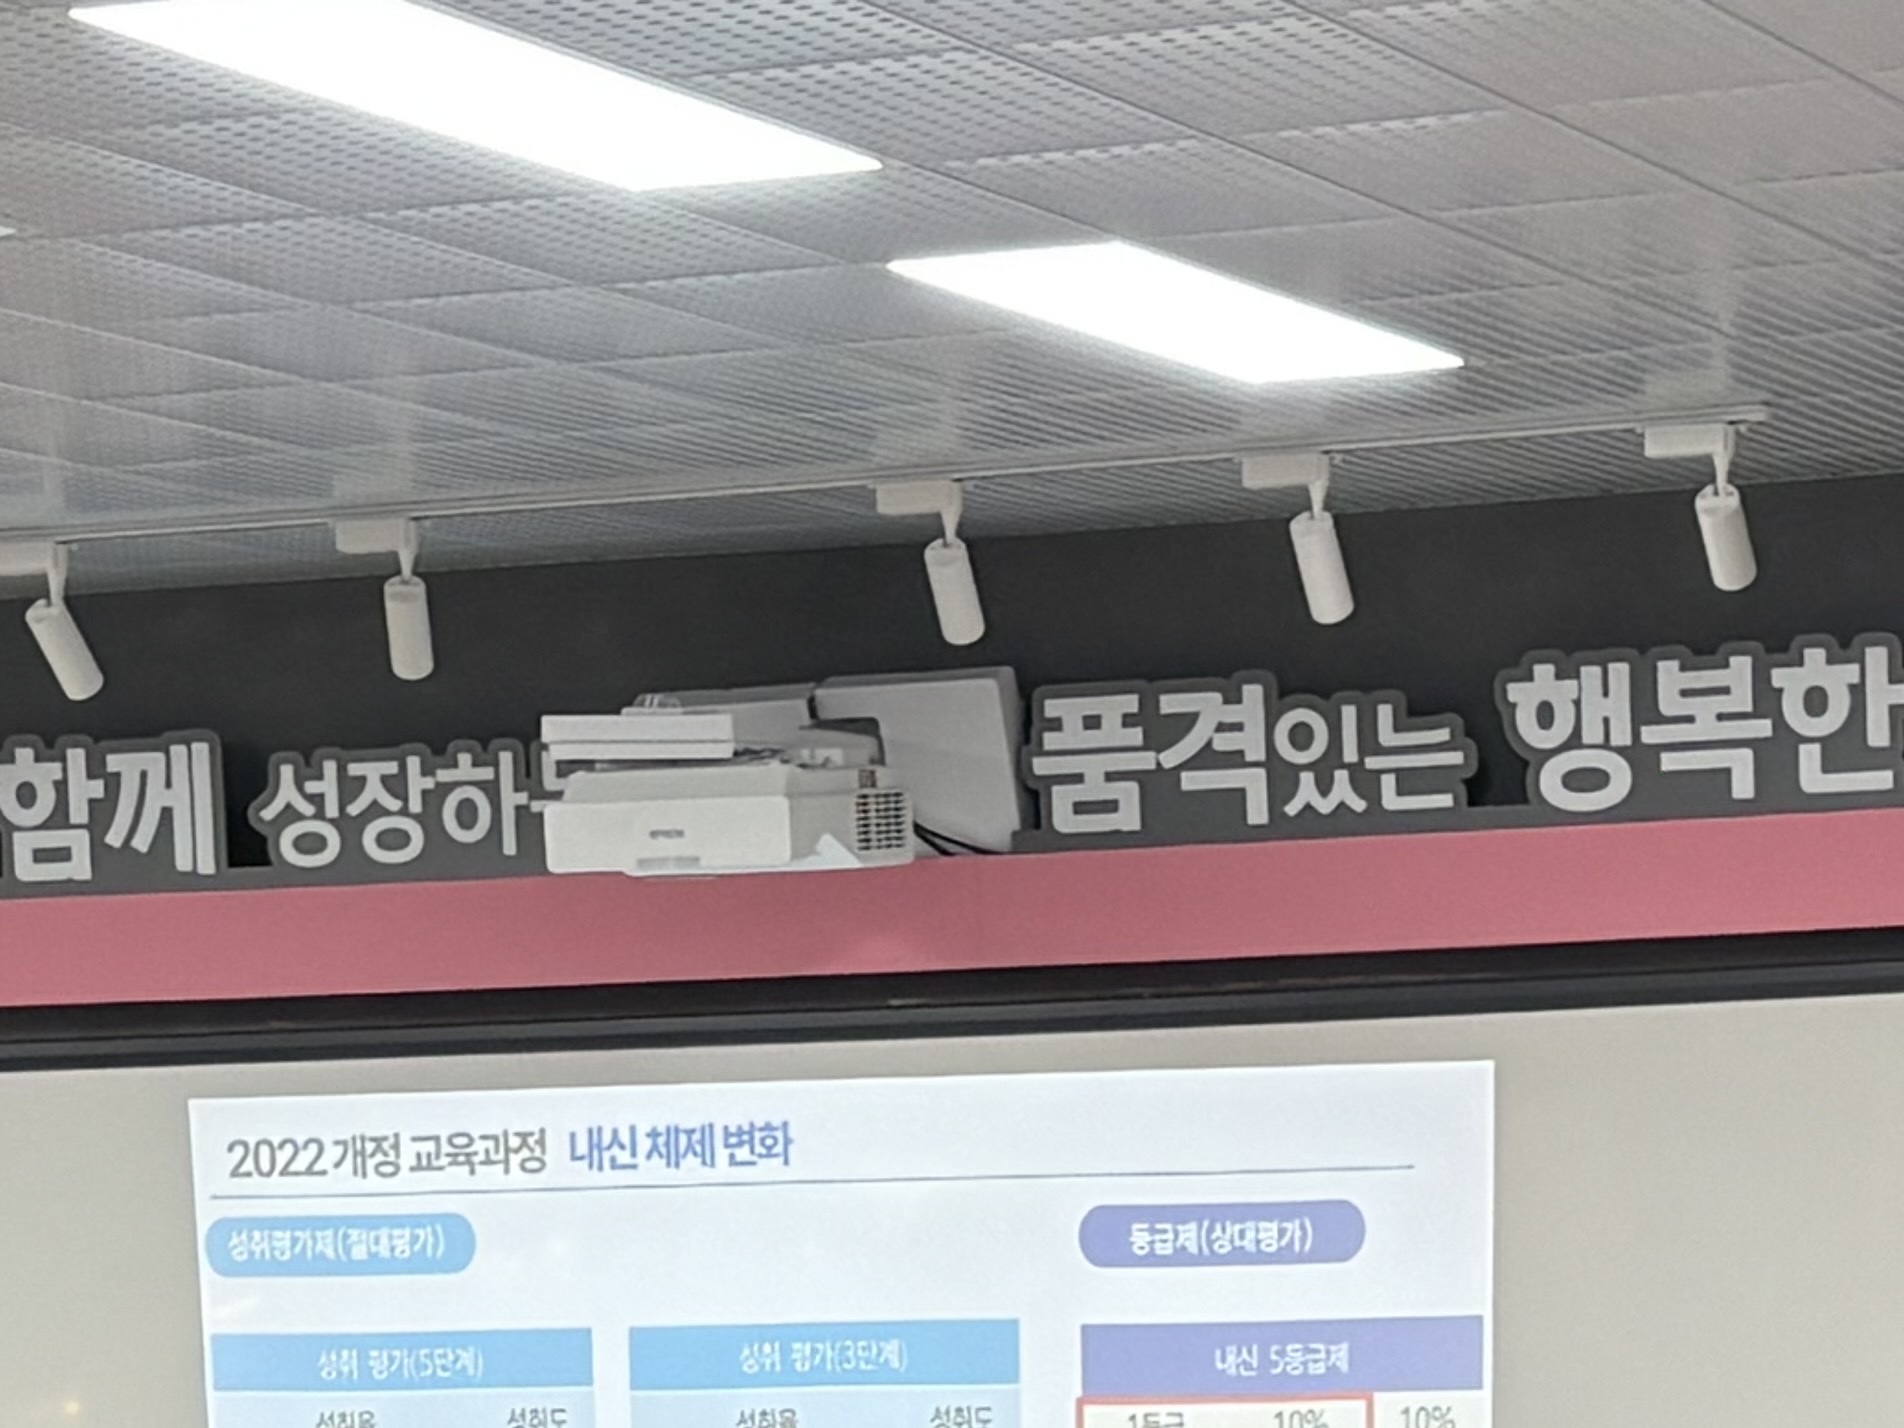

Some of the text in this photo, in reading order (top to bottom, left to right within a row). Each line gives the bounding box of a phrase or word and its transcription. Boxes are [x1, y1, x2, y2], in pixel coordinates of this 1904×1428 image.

[1032, 685, 1466, 833] 품격있는
[227, 1121, 793, 1179] 2022 개정 교육과정 내신 체제 변화
[1130, 1218, 1312, 1255] 등급제(상대평가)
[1215, 1342, 1348, 1376] 내신 5등급제
